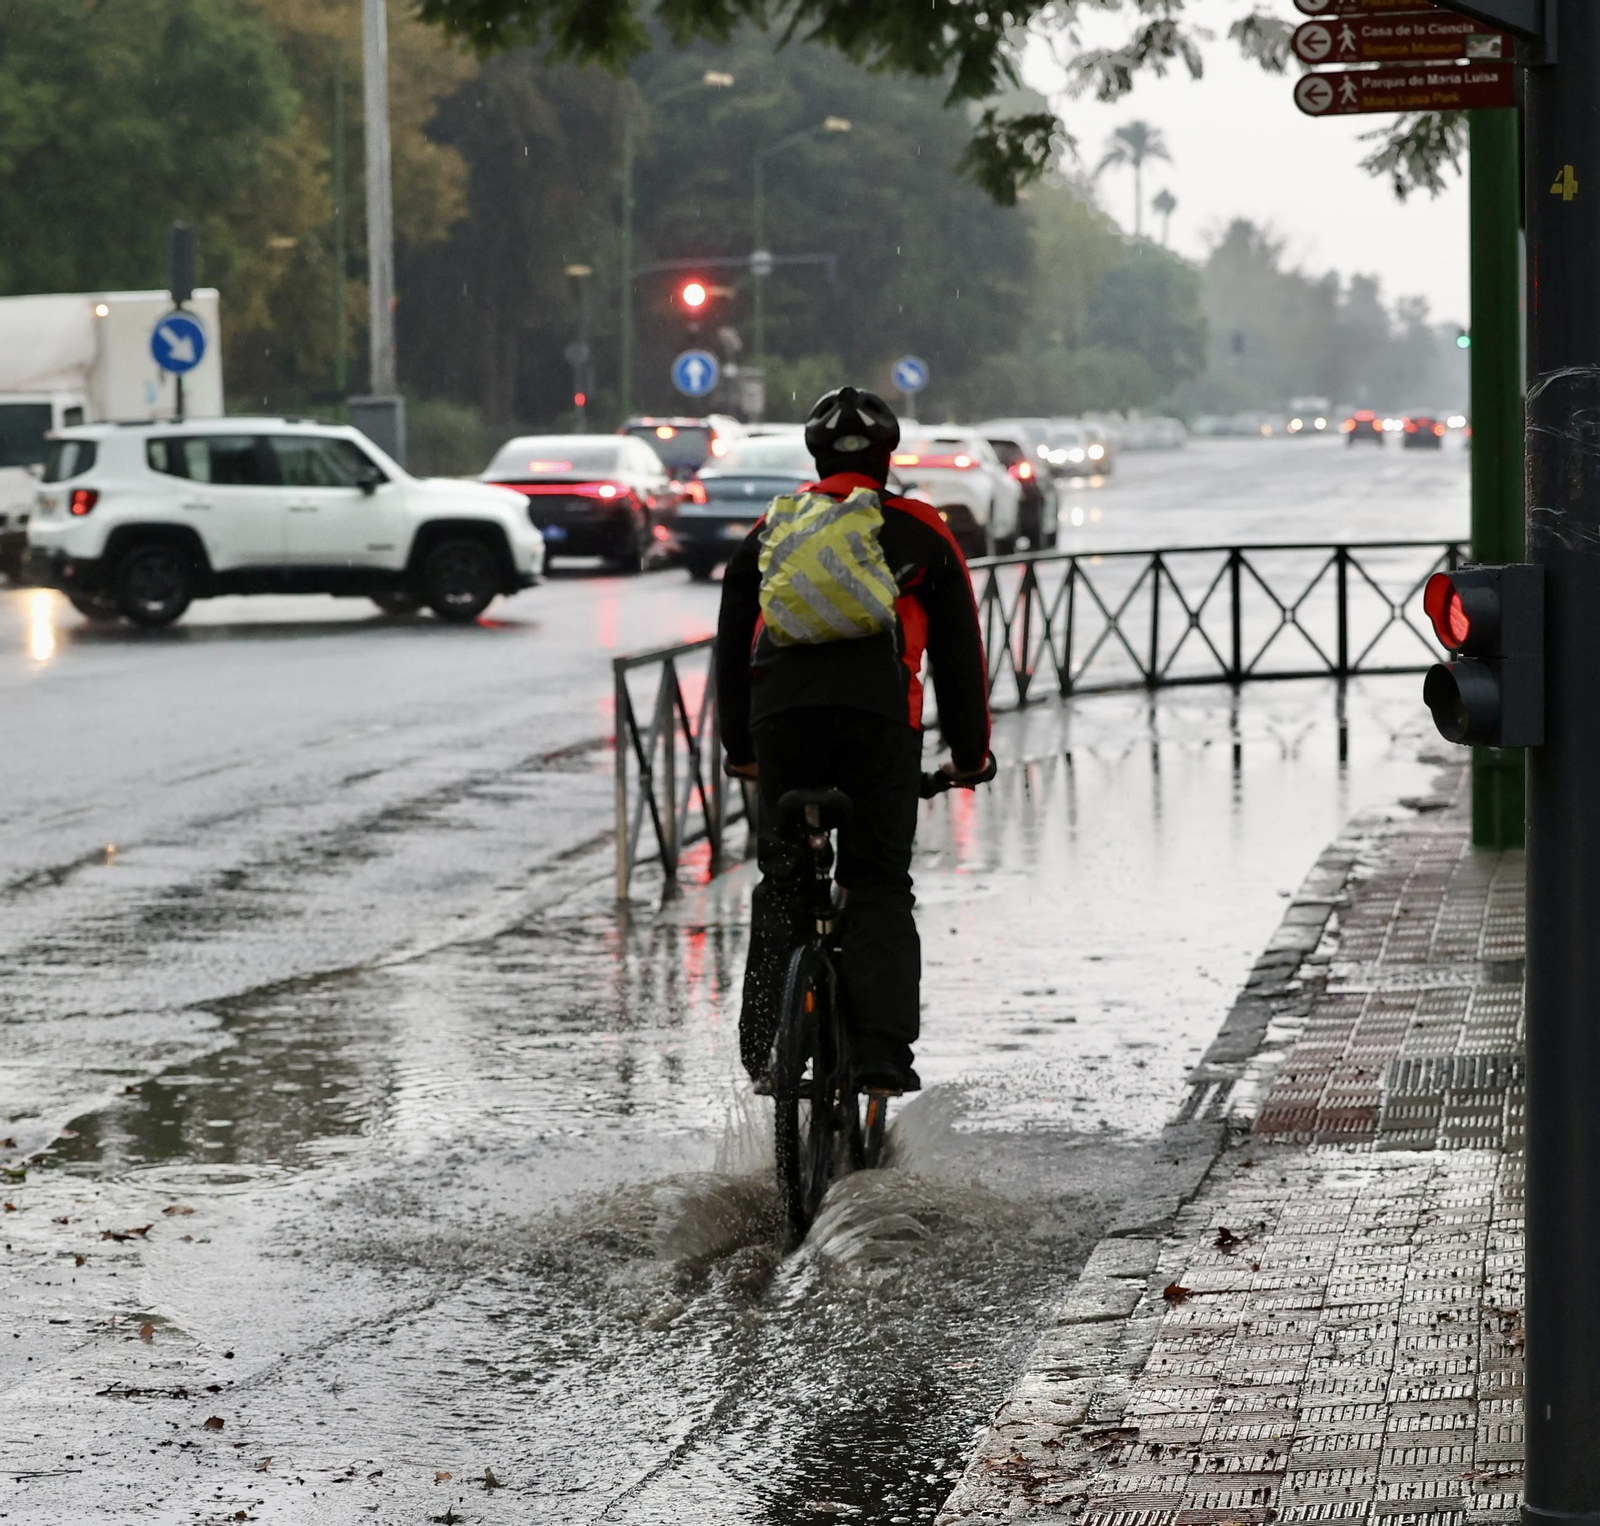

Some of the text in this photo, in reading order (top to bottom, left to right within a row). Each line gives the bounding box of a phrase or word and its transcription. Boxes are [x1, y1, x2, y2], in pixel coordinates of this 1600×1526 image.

[1361, 22, 1475, 37] Casa de la Ciencia
[1411, 41, 1463, 54] Museum
[1362, 76, 1406, 90] Parque
[1408, 75, 1425, 86] de
[1464, 72, 1499, 84] Luisa
[1433, 91, 1460, 103] Park
[1549, 164, 1578, 201] 4
